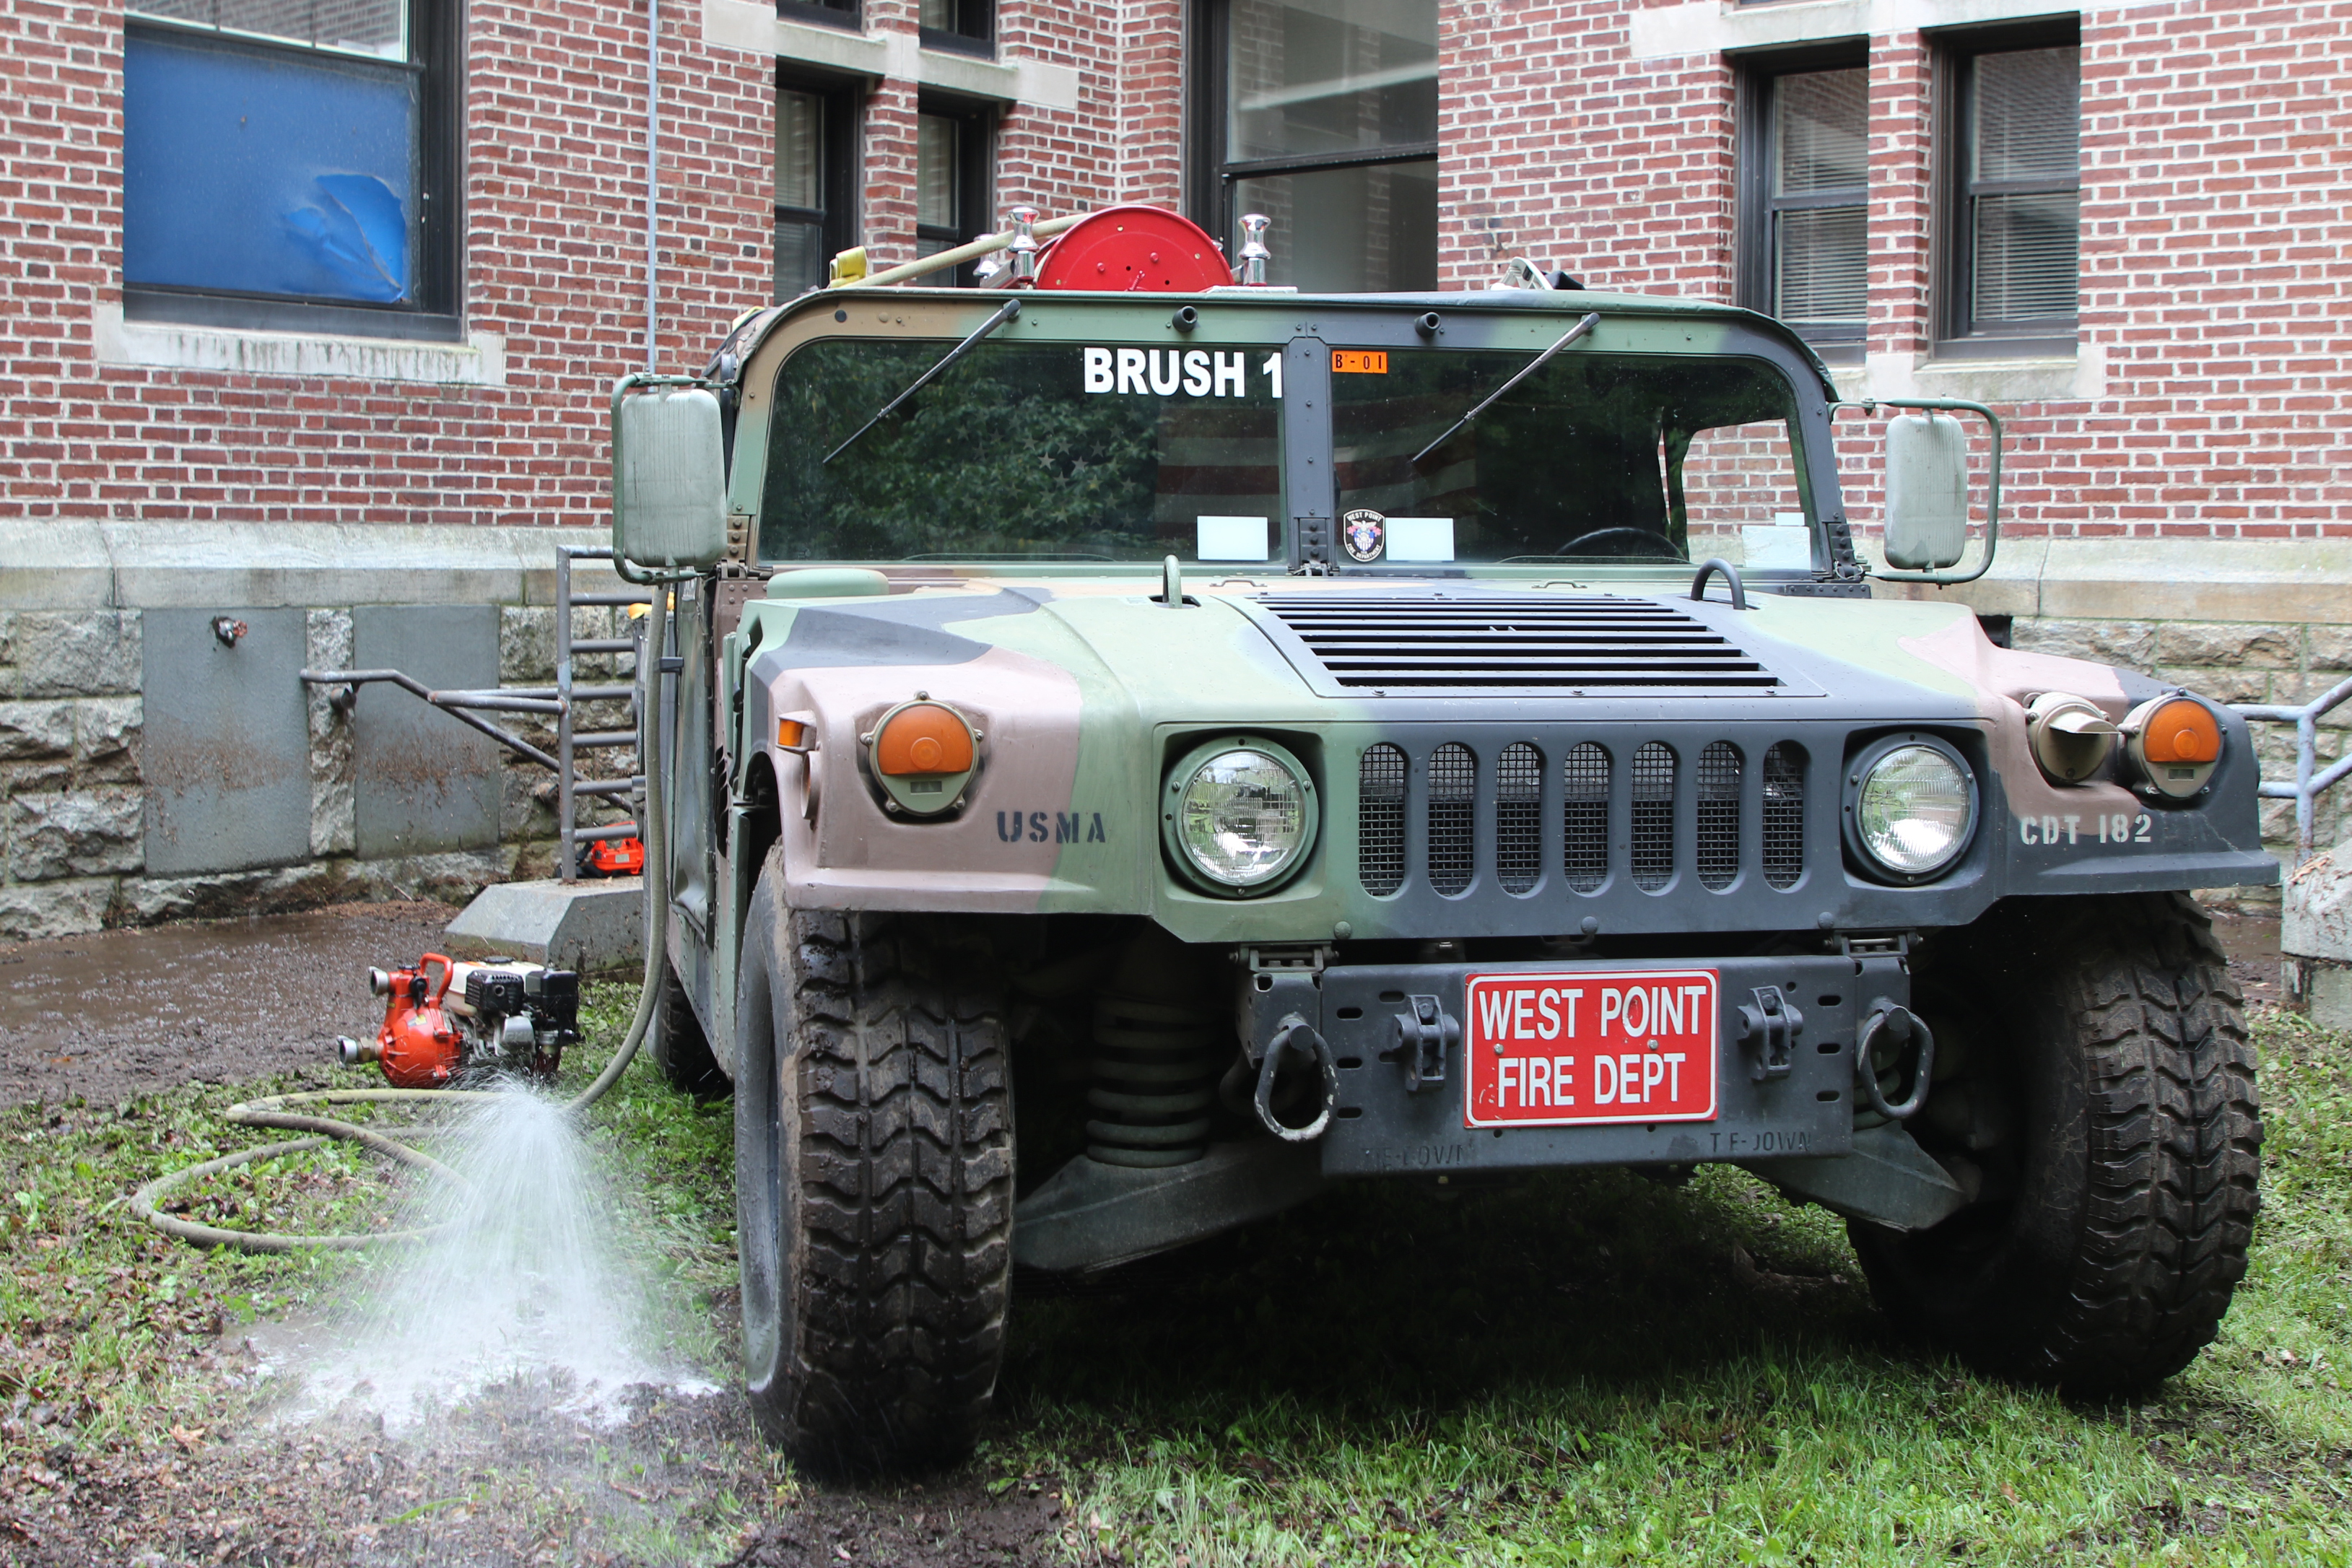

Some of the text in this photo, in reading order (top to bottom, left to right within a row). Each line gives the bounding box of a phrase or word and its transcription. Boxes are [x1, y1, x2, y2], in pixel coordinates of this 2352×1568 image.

[1084, 347, 1283, 398] BRUSH 1
[1346, 512, 1382, 522] WEST POINT
[997, 811, 1106, 844] USMA
[2021, 814, 2152, 845] CDT 182
[1478, 985, 1707, 1040] WEST POINT
[1497, 1052, 1686, 1108] FIRE DEPT
